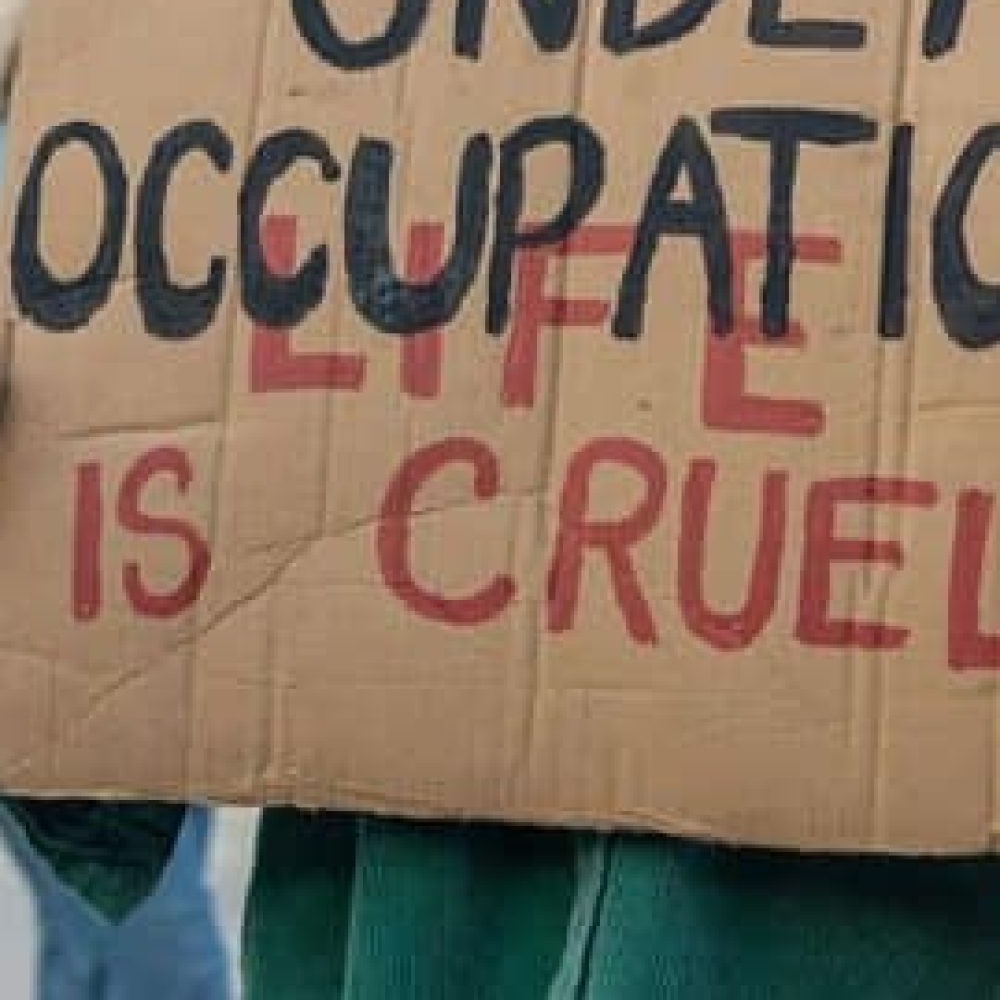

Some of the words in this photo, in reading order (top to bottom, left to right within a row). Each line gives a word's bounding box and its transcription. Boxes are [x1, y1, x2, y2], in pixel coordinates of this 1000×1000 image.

[250, 214, 843, 438] LIFE
[72, 446, 211, 623] IS
[377, 436, 1000, 671] CRUEL
